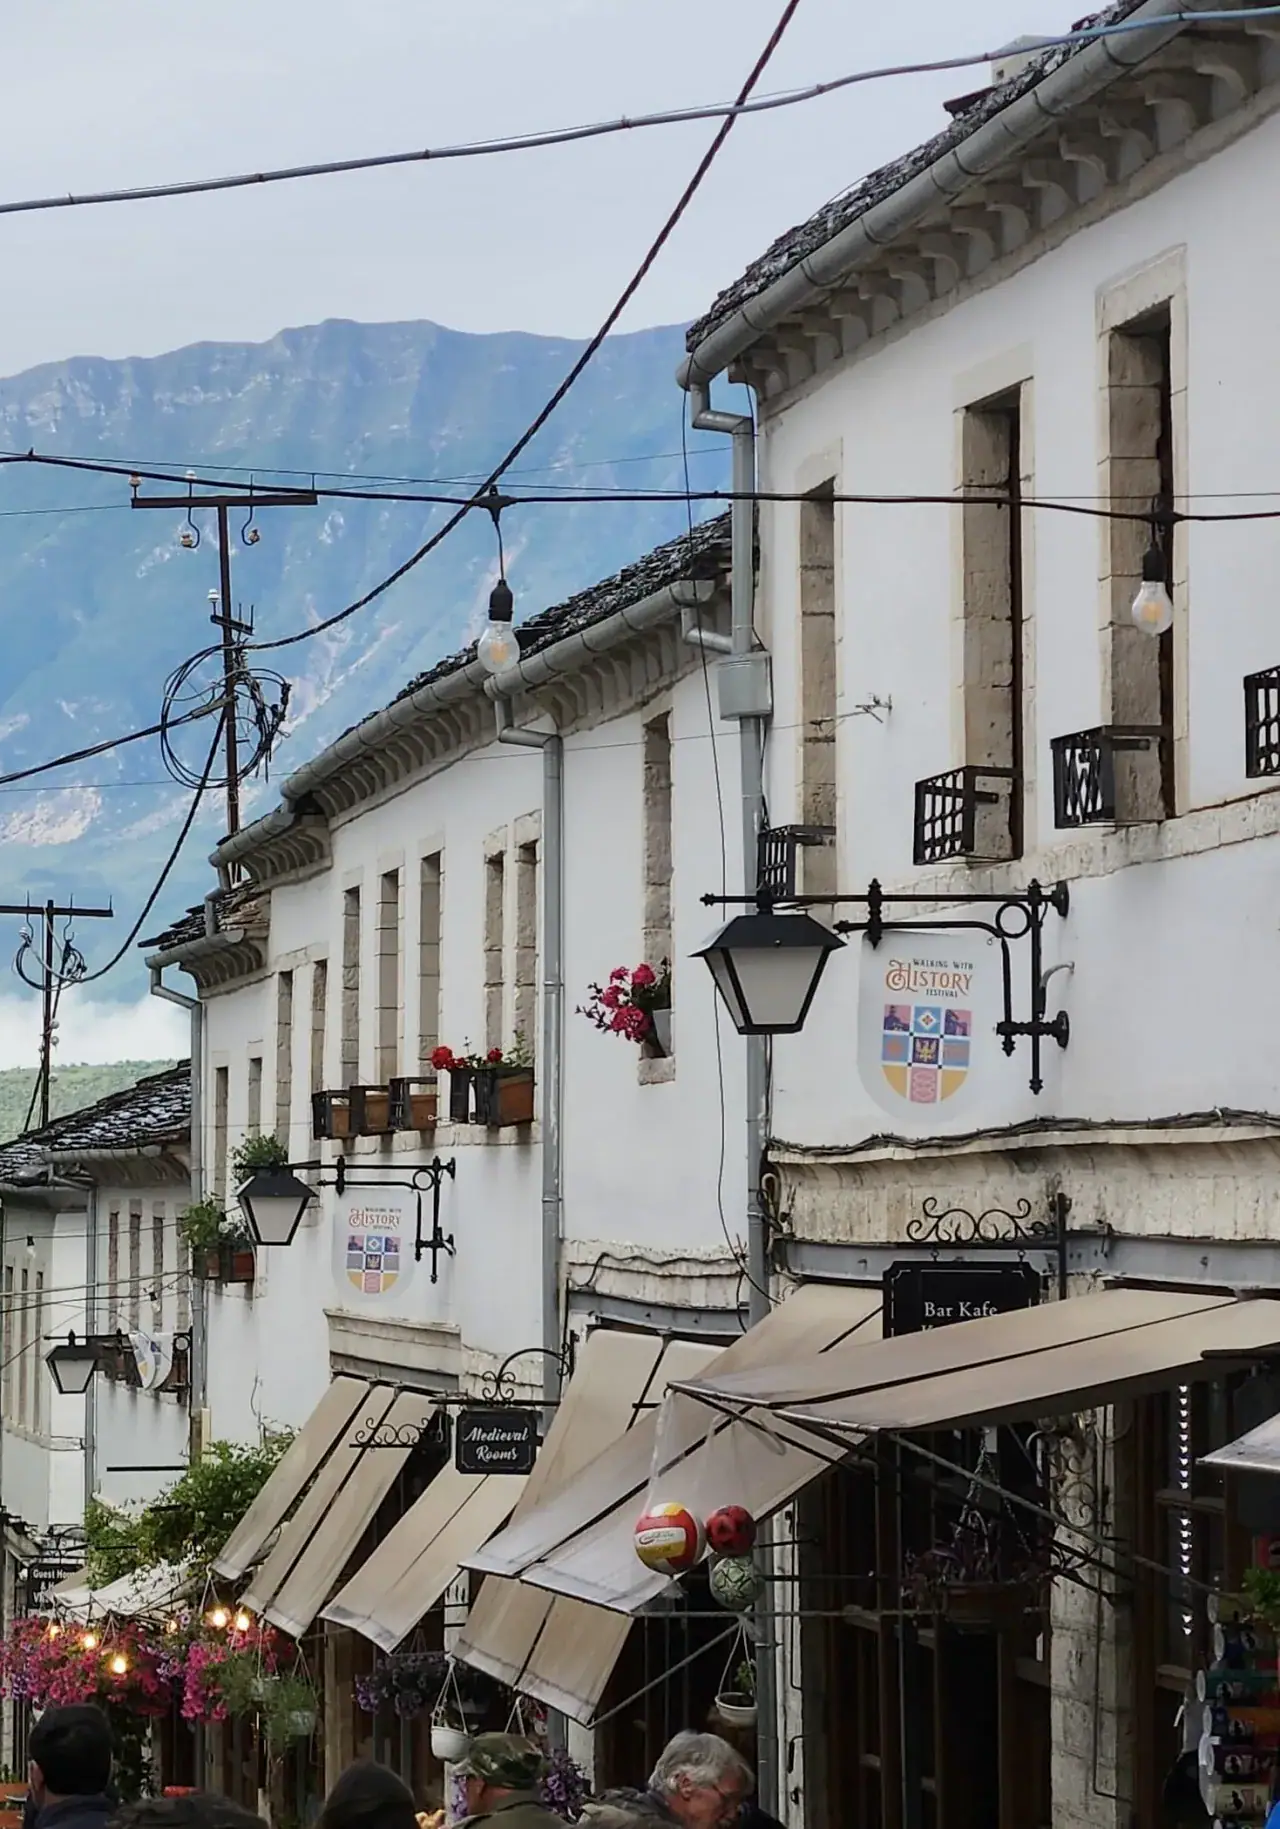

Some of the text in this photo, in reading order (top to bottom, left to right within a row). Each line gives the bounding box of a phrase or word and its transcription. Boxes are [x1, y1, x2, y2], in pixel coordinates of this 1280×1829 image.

[913, 958, 974, 970] WALKING WITH
[886, 959, 973, 996] HISTORY
[926, 988, 958, 998] FESTIVAL
[349, 1208, 400, 1229] HISTORY
[924, 1300, 998, 1317] Bar Kafe
[463, 1426, 529, 1442] Medieval
[476, 1445, 518, 1463] Rooms
[33, 1569, 55, 1579] Guest
